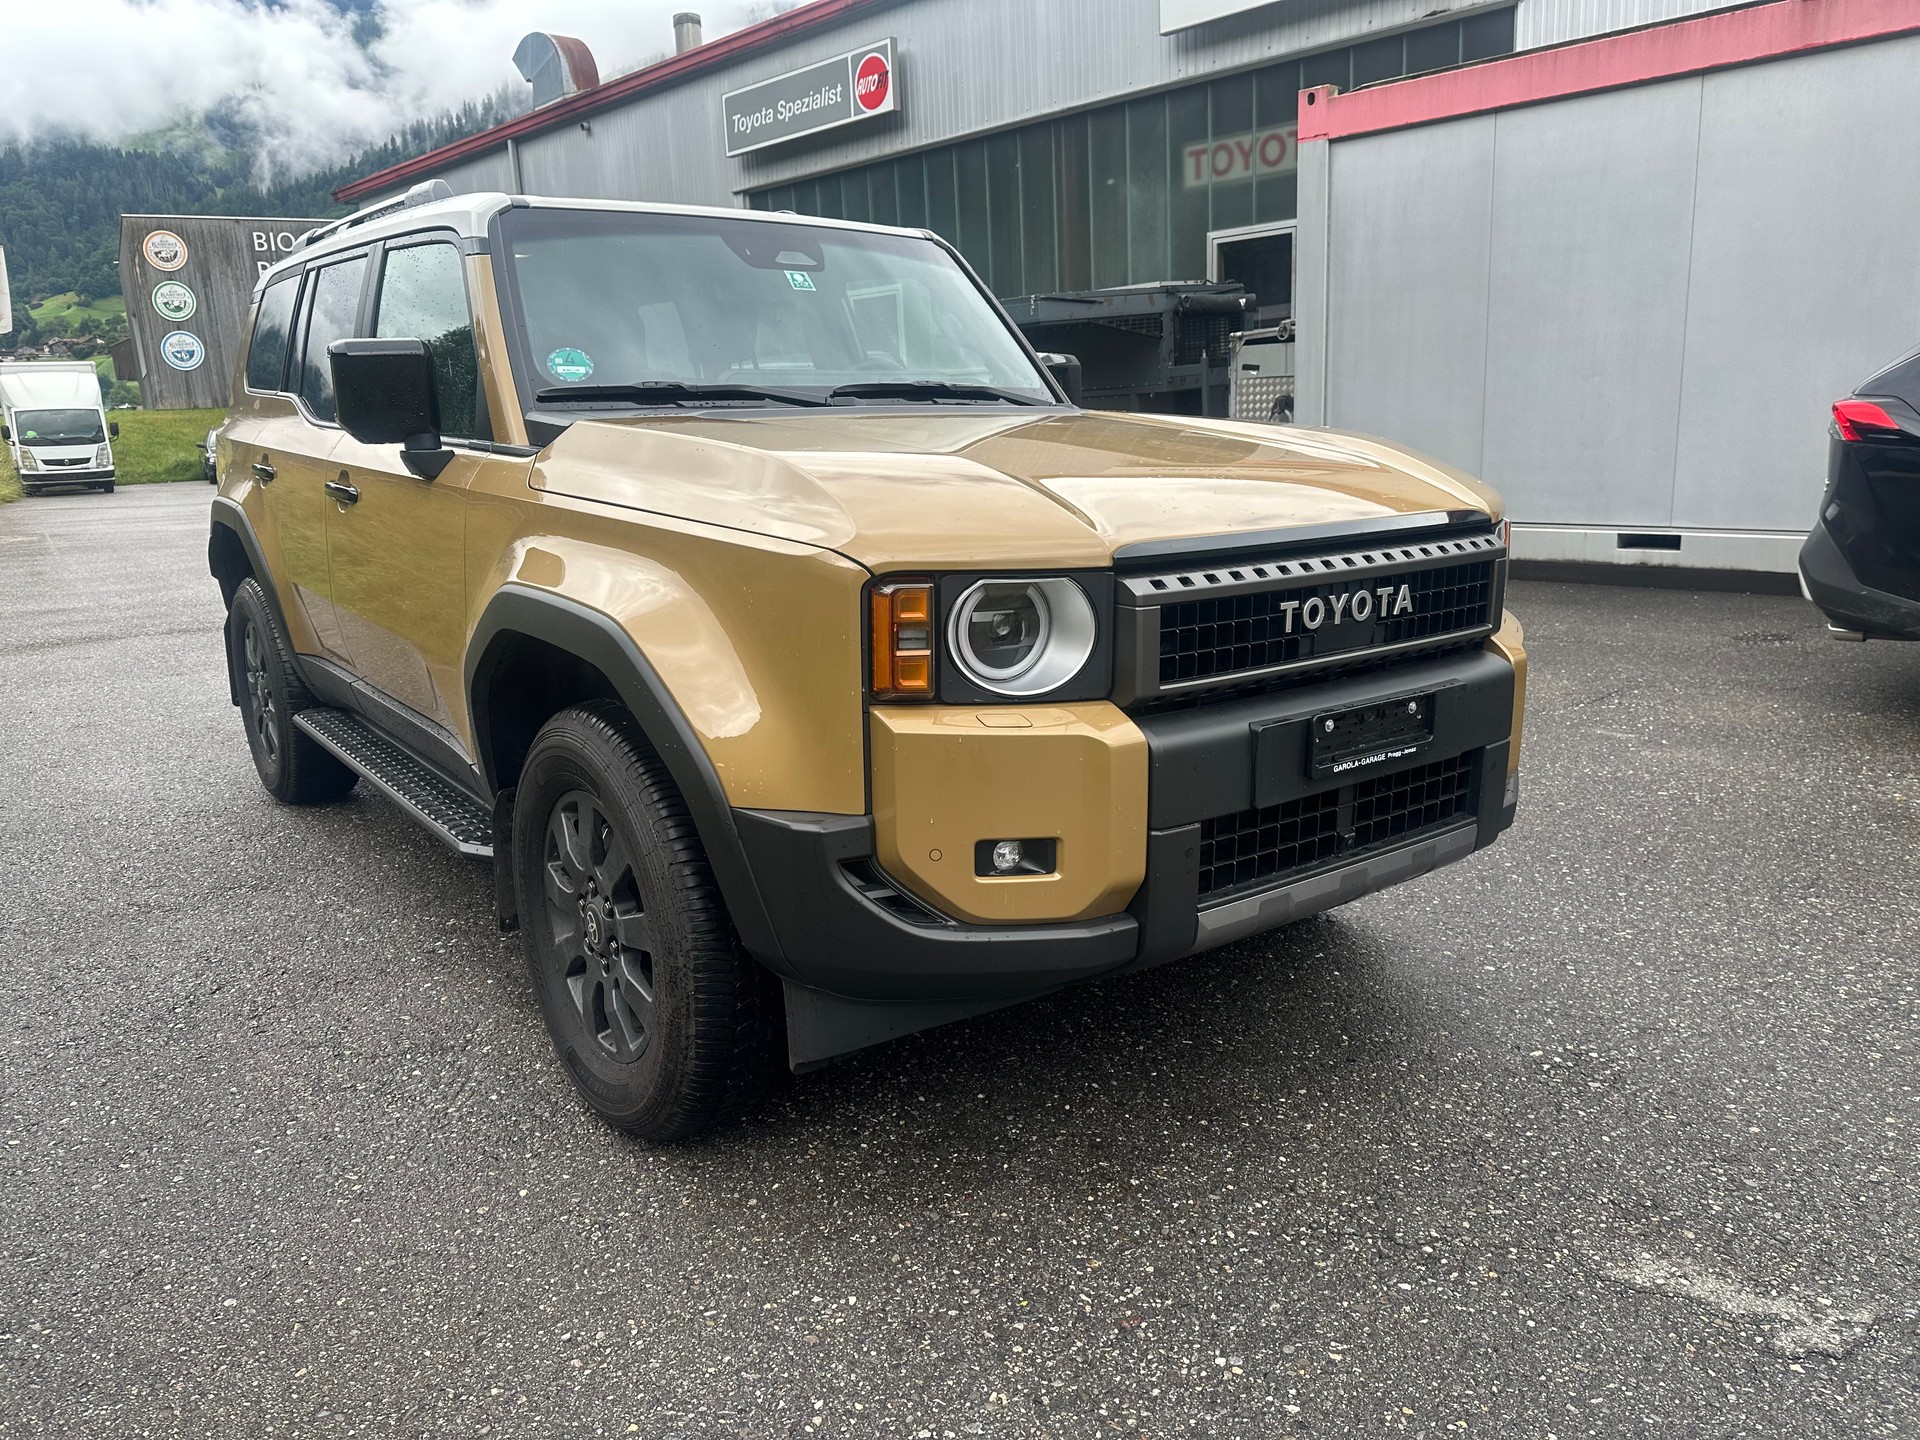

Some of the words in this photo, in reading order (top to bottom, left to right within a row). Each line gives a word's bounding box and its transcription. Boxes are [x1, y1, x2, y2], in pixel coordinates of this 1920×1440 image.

[732, 107, 774, 134] Toyota
[777, 83, 843, 122] Spezialist
[252, 231, 296, 252] BIO
[564, 352, 576, 366] 4
[1280, 584, 1413, 633] TOYOTA
[1333, 753, 1386, 773] GAROLA-GARAGE
